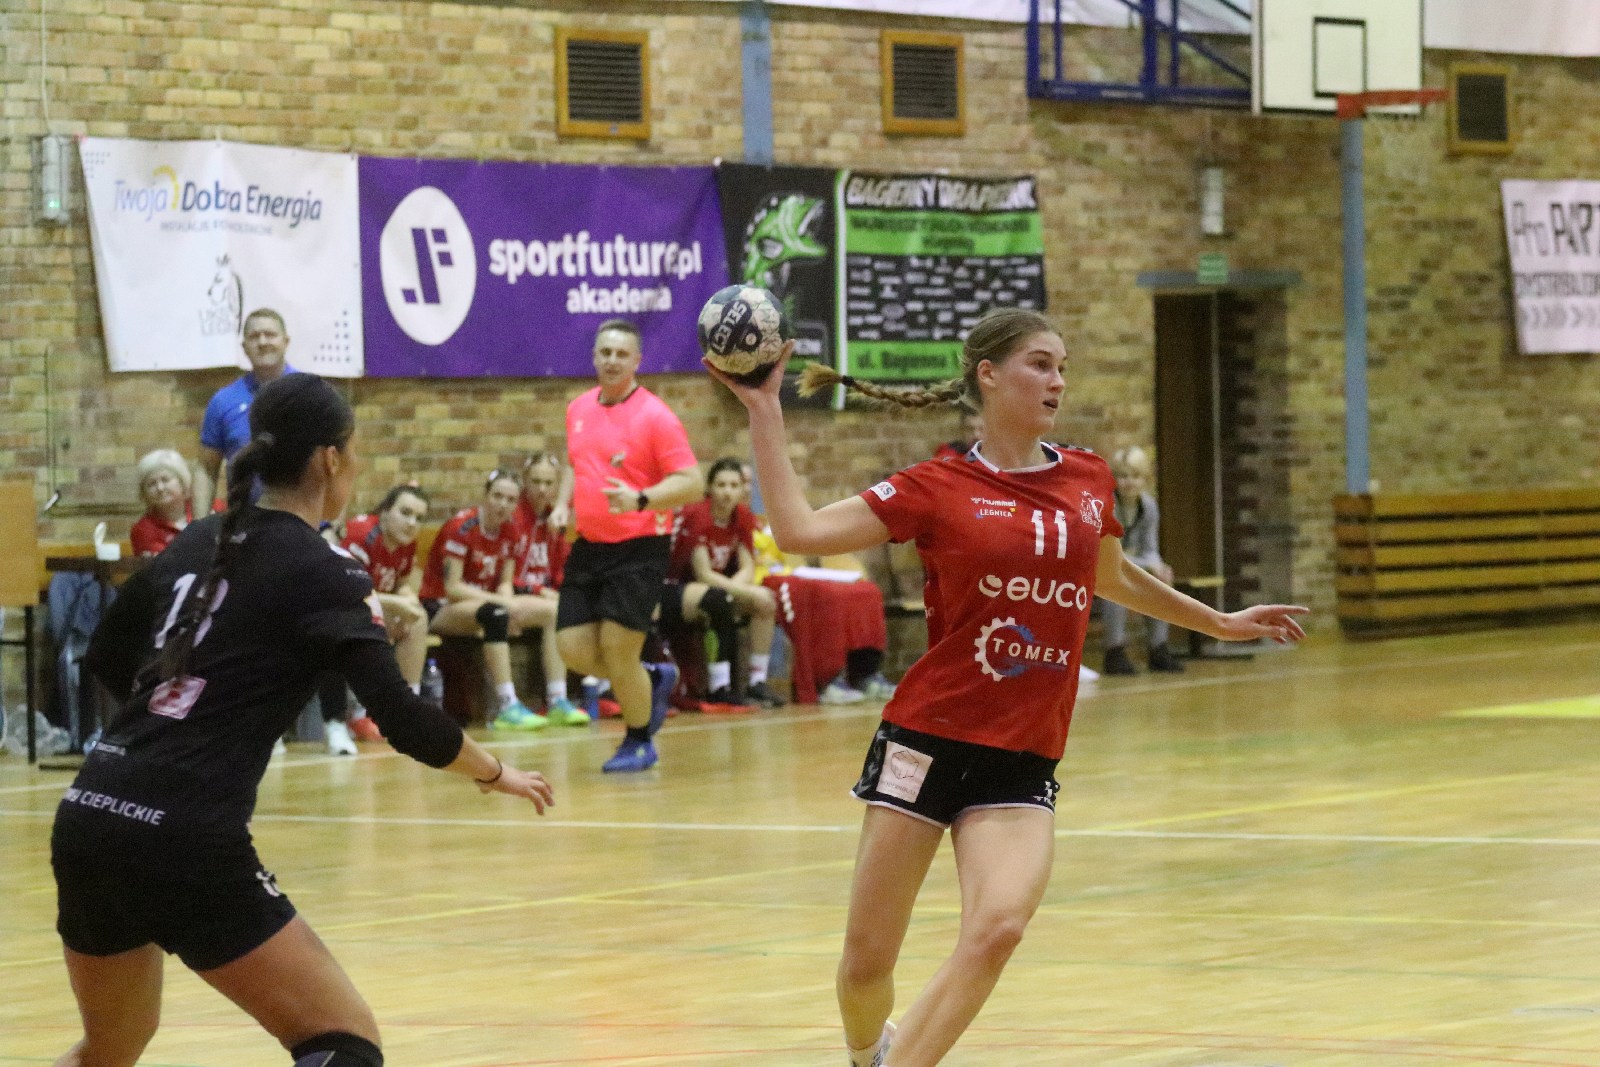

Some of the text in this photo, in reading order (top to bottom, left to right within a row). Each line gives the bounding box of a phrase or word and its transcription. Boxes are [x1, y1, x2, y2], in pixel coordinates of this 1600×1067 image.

[114, 180, 168, 222] Twoja
[247, 185, 323, 229] Energia
[712, 301, 748, 351] SELECT
[979, 508, 1013, 518] LEGNICA
[982, 497, 1017, 507] hummel
[1031, 509, 1068, 559] 11
[1006, 576, 1087, 611] euco
[992, 637, 1071, 666] TOMEX
[80, 790, 166, 826] CIEPLICKIE
